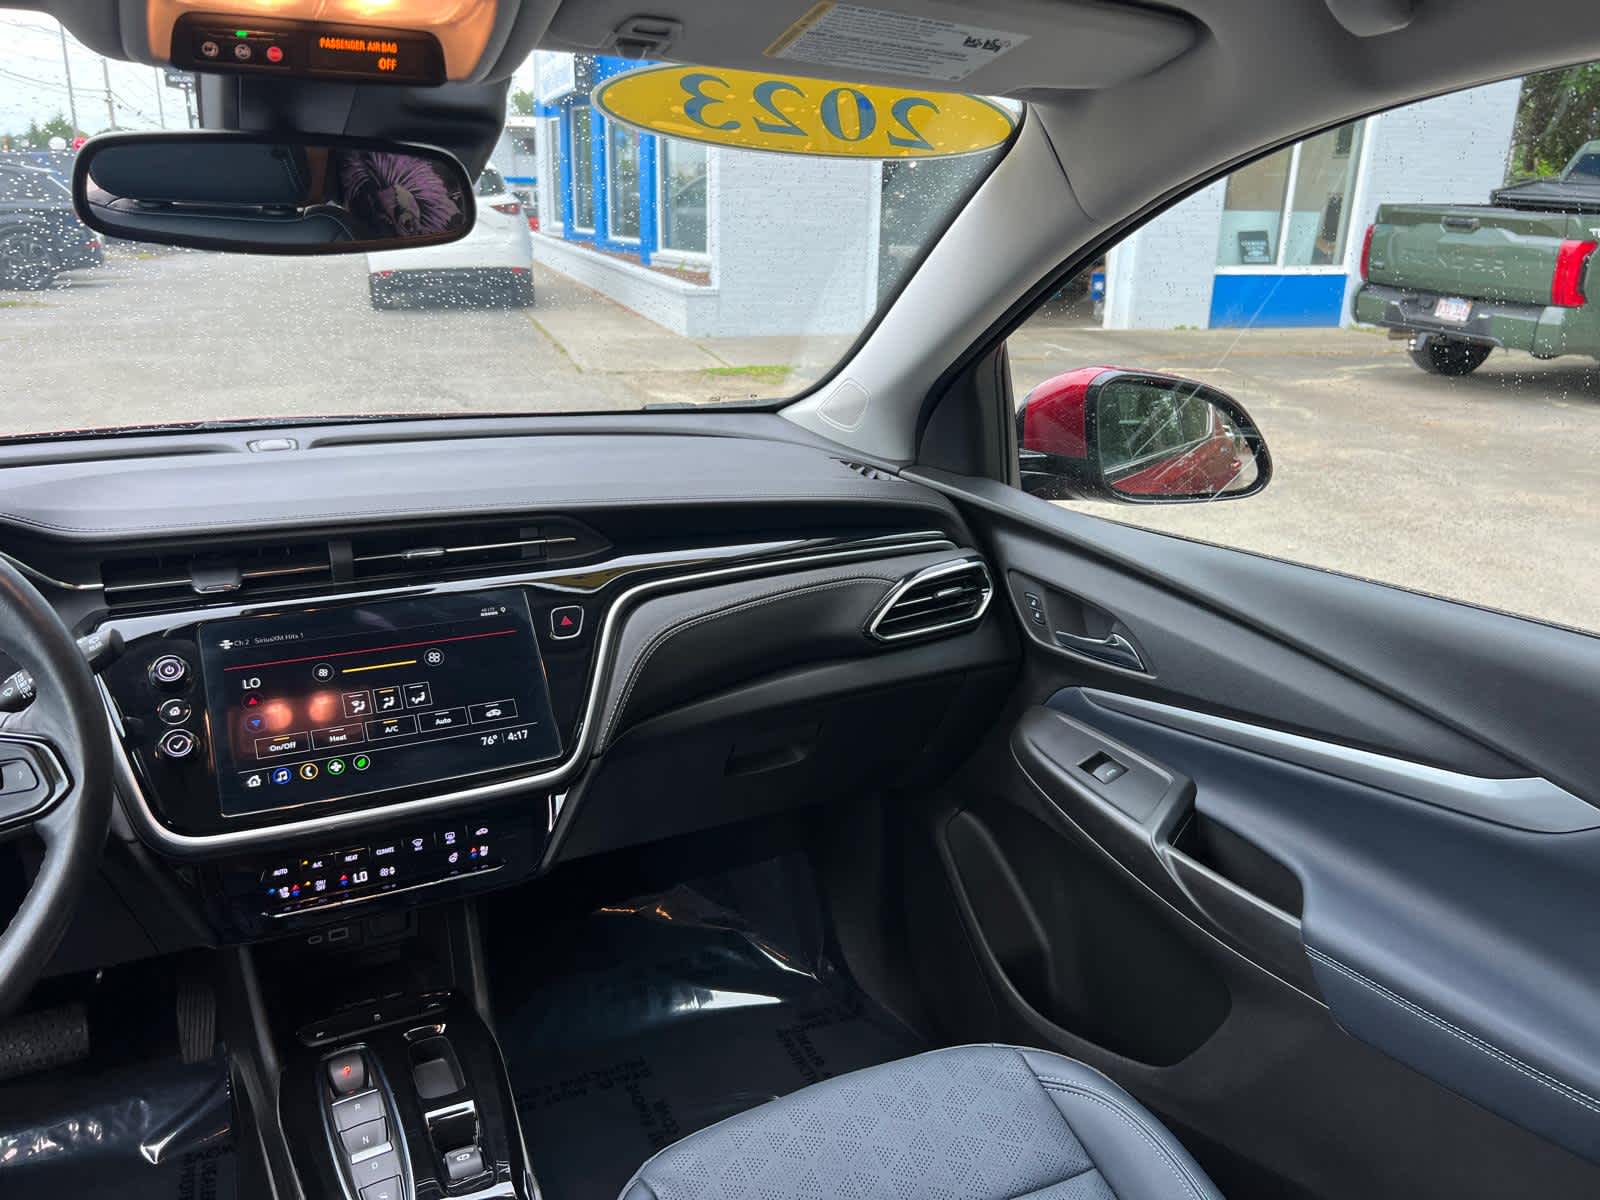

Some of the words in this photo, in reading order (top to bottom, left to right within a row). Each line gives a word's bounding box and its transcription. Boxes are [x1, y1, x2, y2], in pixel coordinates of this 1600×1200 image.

[319, 36, 366, 51] PASSENGER
[378, 57, 397, 71] OFF
[242, 677, 261, 690] LO
[435, 717, 452, 726] Auto
[385, 725, 399, 733] A/C
[329, 734, 347, 743] Heat
[507, 729, 529, 742] 4:17
[269, 741, 297, 751] On/Off
[345, 854, 358, 862] HEAT
[273, 868, 288, 876] AUTO
[353, 871, 368, 883] LO
[342, 1064, 352, 1077] P
[362, 1135, 370, 1145] N
